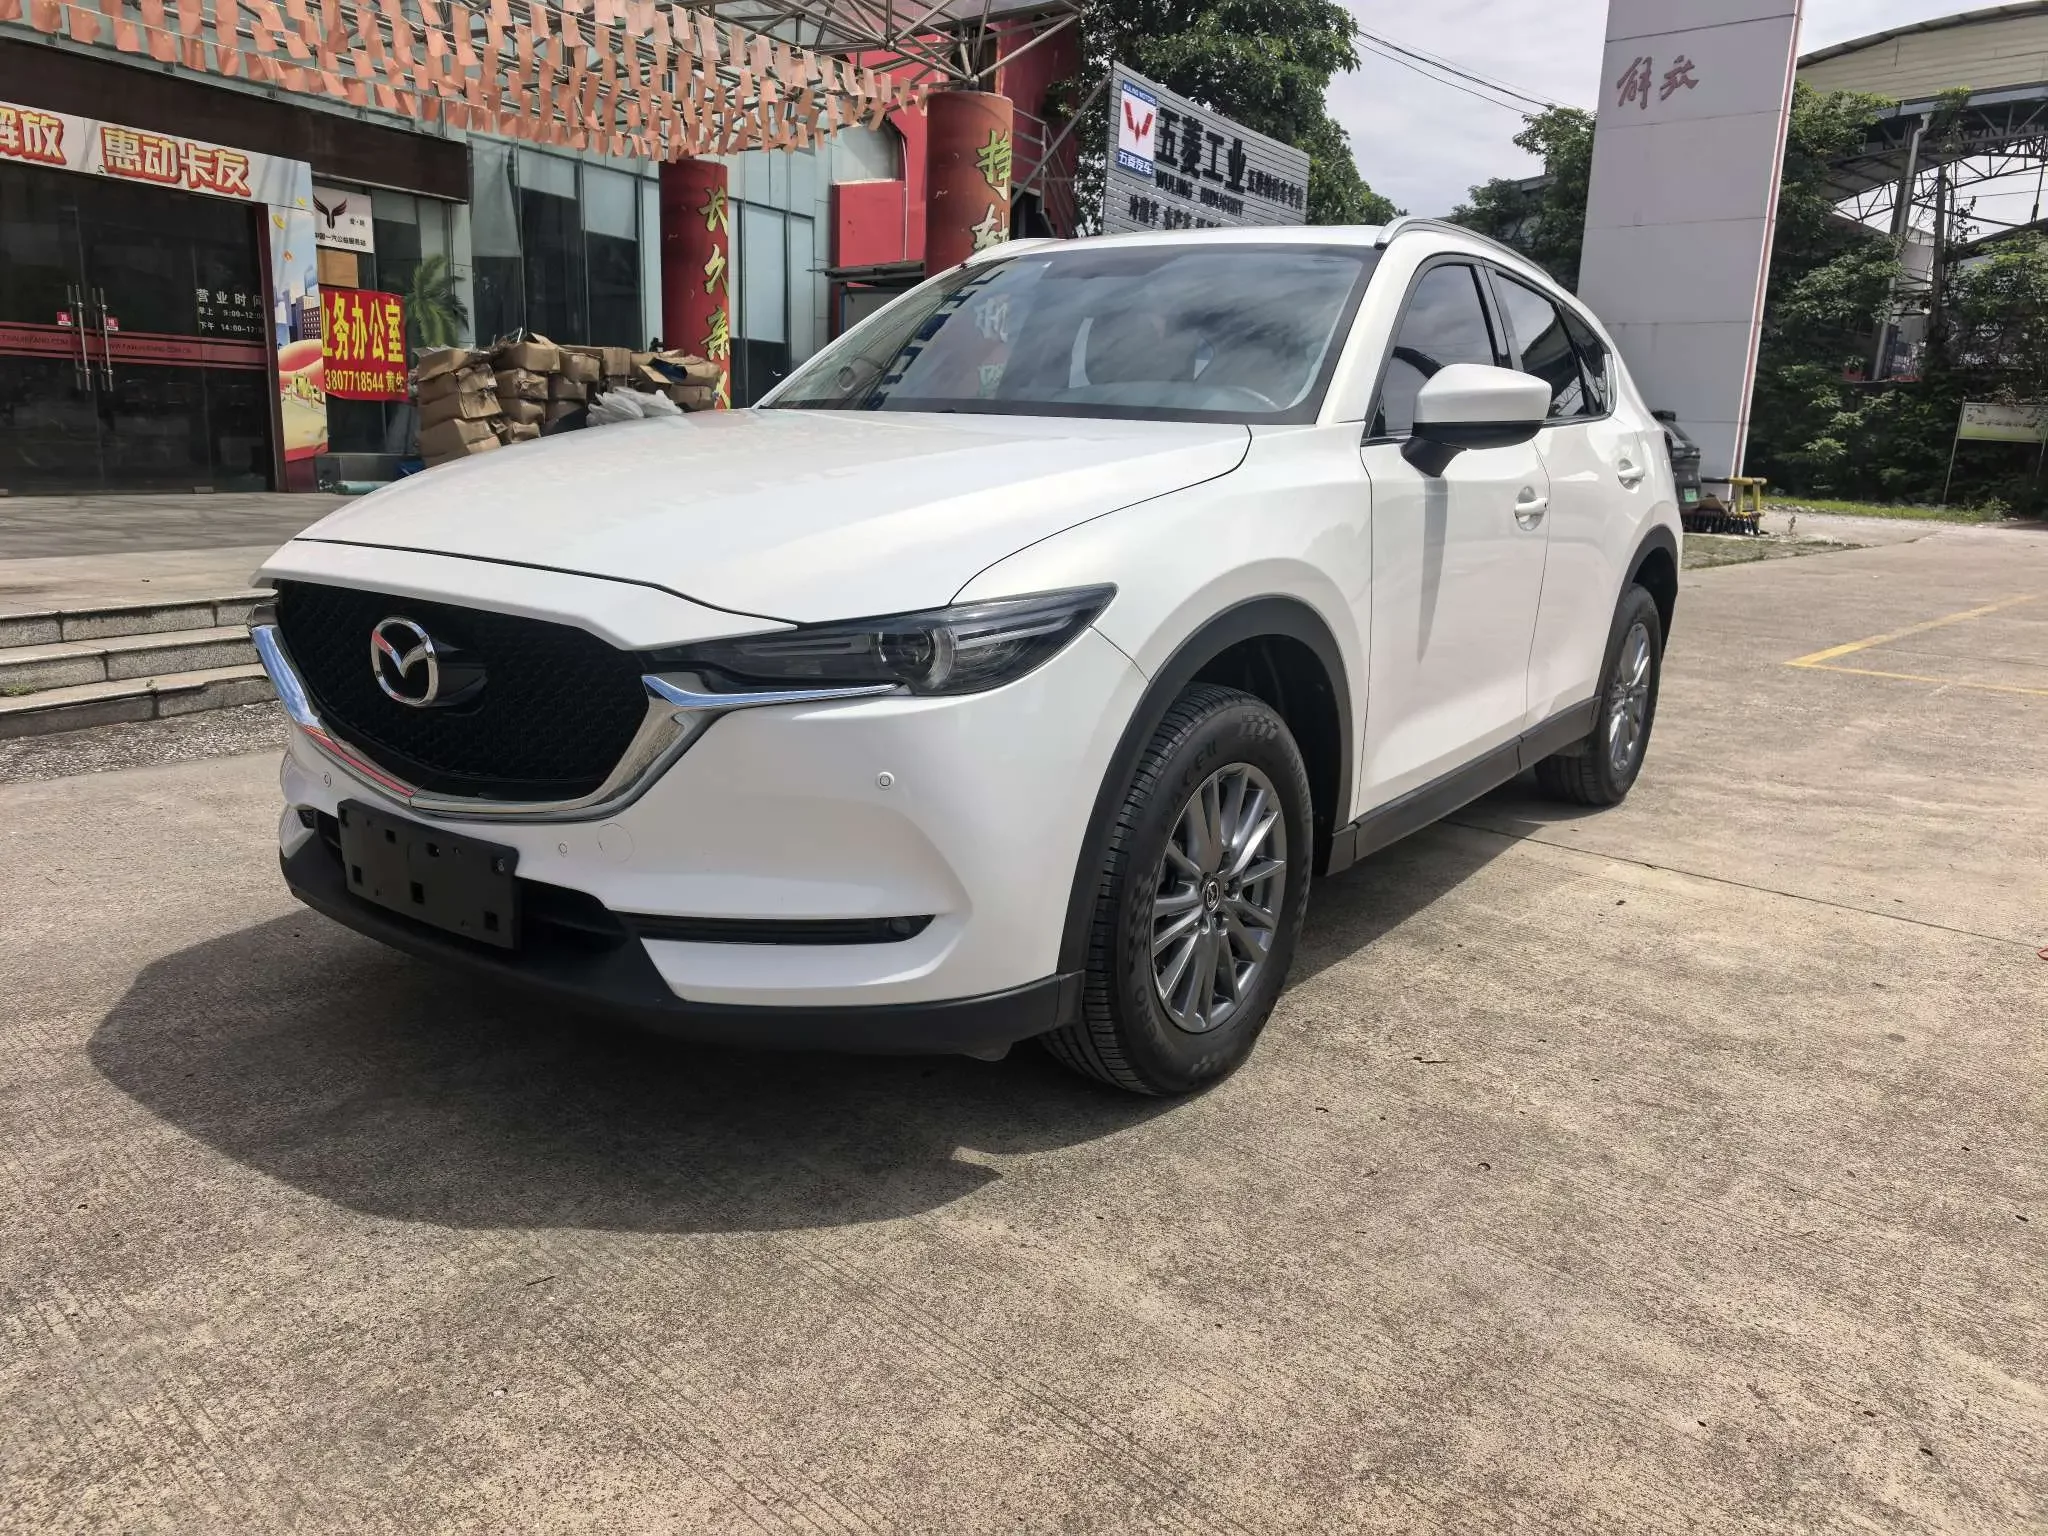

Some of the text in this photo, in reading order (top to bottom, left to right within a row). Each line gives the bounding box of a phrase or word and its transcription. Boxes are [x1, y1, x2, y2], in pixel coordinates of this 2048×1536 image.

[101, 127, 252, 197] 惠动卡友
[1118, 151, 1154, 176] 五菱汽车
[1155, 107, 1247, 194] 五菱工业
